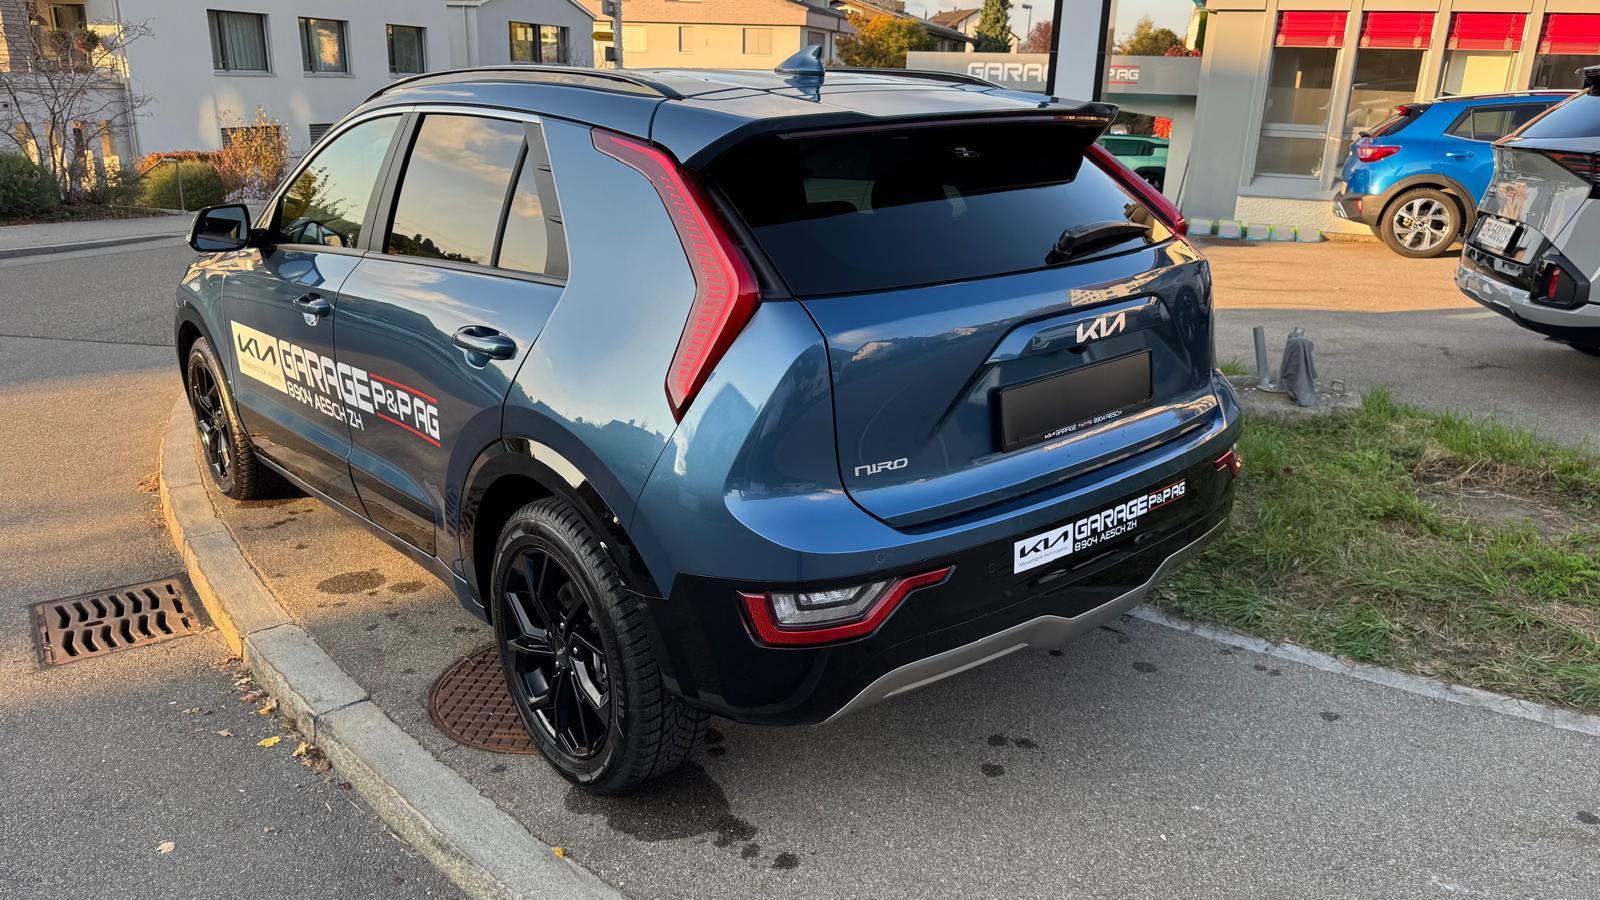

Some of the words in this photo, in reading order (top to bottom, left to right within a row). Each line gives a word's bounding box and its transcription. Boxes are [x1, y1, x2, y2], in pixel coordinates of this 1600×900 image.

[1116, 69, 1140, 80] AG
[1076, 312, 1126, 344] KIA
[237, 332, 277, 366] KIA
[278, 339, 375, 414] GARAGE
[370, 379, 412, 421] P&P
[413, 397, 441, 441] AG
[287, 381, 314, 410] 8904
[314, 393, 348, 424] AESCH
[348, 409, 365, 431] ZH
[1055, 423, 1078, 436] GARAGE
[1093, 414, 1106, 424] 8904
[1105, 410, 1123, 420] AESCH
[854, 457, 909, 477] NIRO
[1019, 530, 1069, 559] KIA
[1074, 495, 1149, 541] GARAGE
[1148, 488, 1171, 509] P&P
[1171, 481, 1186, 498] AG
[1074, 537, 1099, 552] 8904
[1099, 526, 1126, 542] AESCH
[1126, 520, 1138, 533] ZH
